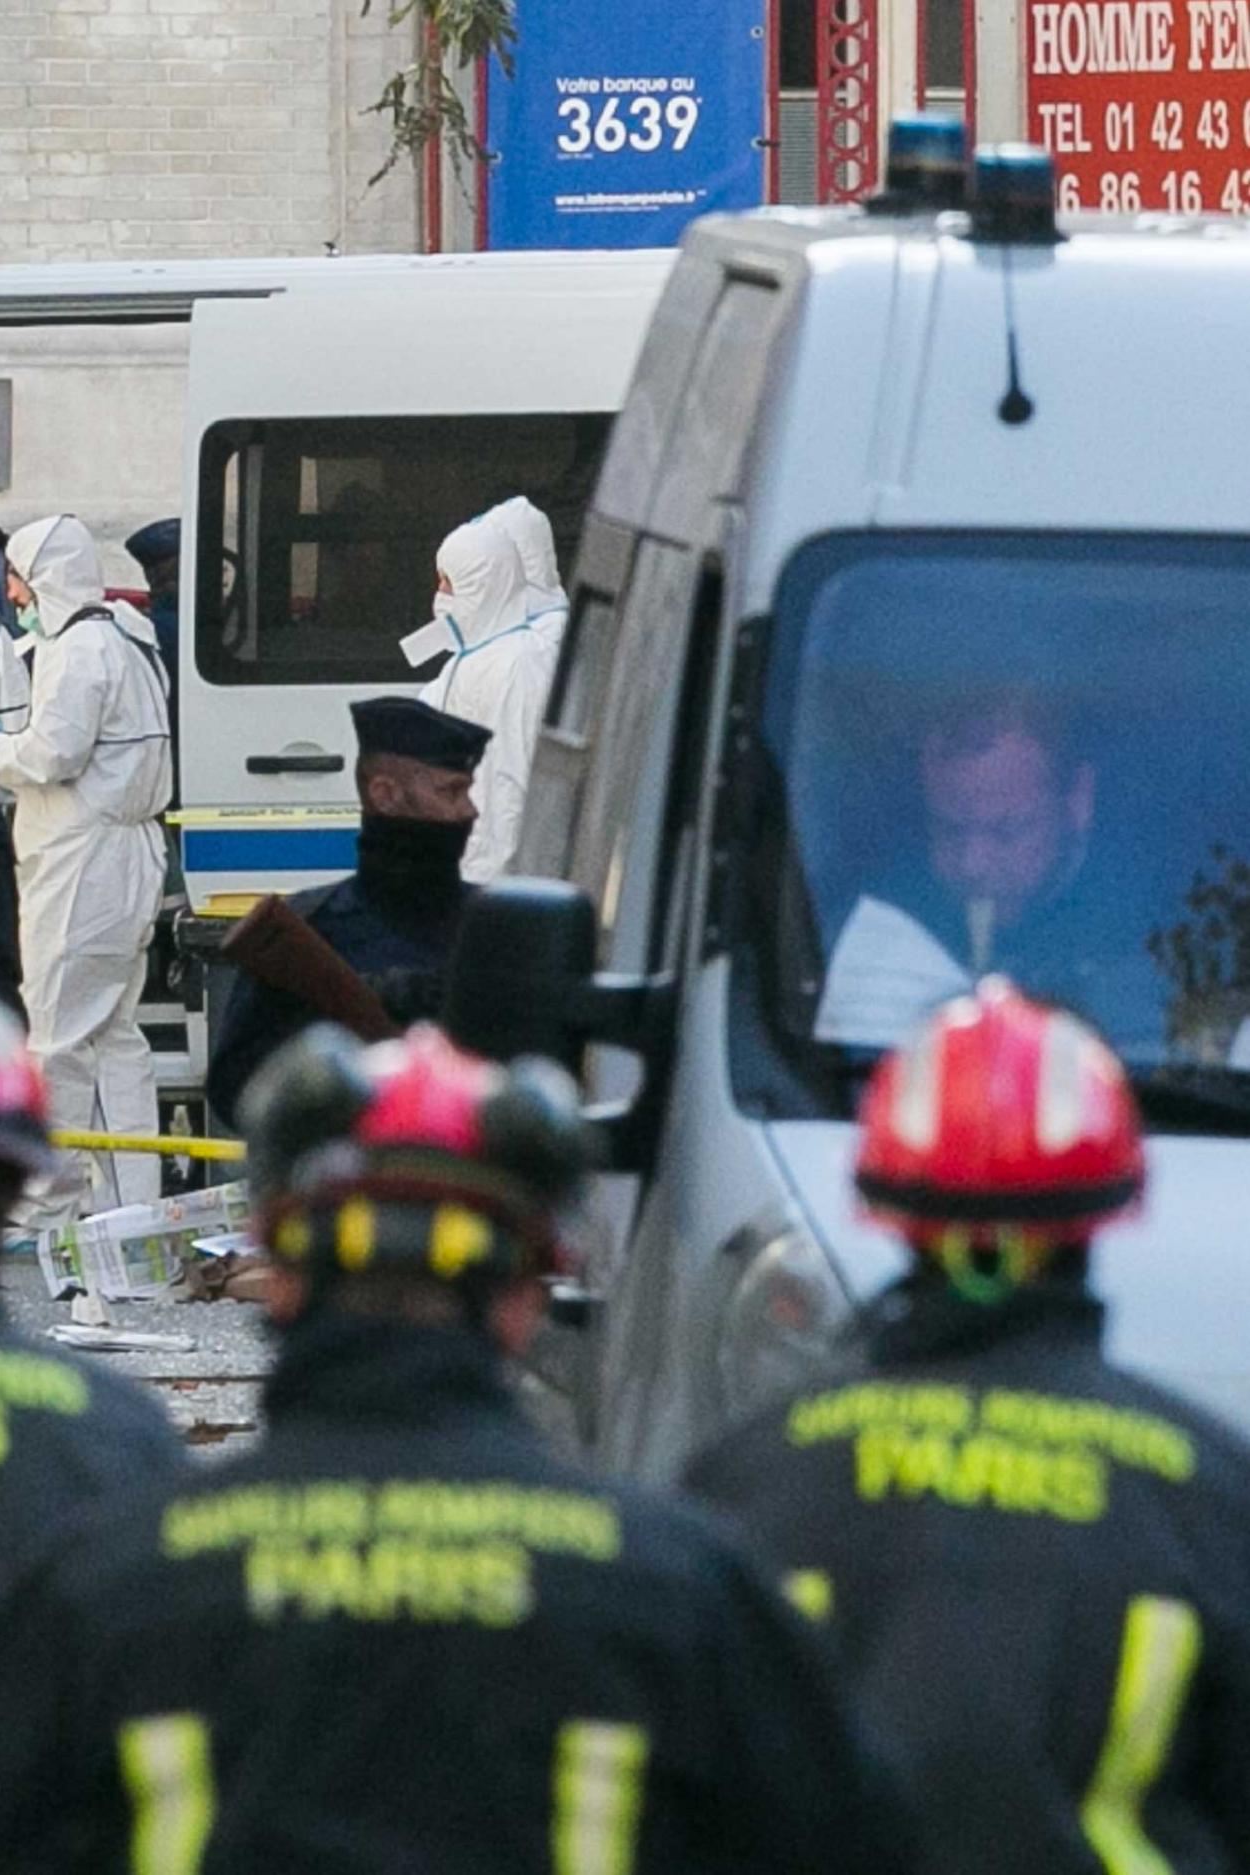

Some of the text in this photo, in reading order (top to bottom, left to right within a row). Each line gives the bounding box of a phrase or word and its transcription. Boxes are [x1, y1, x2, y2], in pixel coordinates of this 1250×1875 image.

[1032, 2, 1175, 74] HOMME
[556, 76, 695, 94] Votre banque au
[557, 96, 698, 152] 3639
[1038, 103, 1092, 152] TEL
[1105, 101, 1134, 151] 01
[1151, 101, 1183, 150] 42
[1196, 100, 1229, 149] 43
[1100, 171, 1141, 213] 86
[1161, 170, 1202, 213] 16
